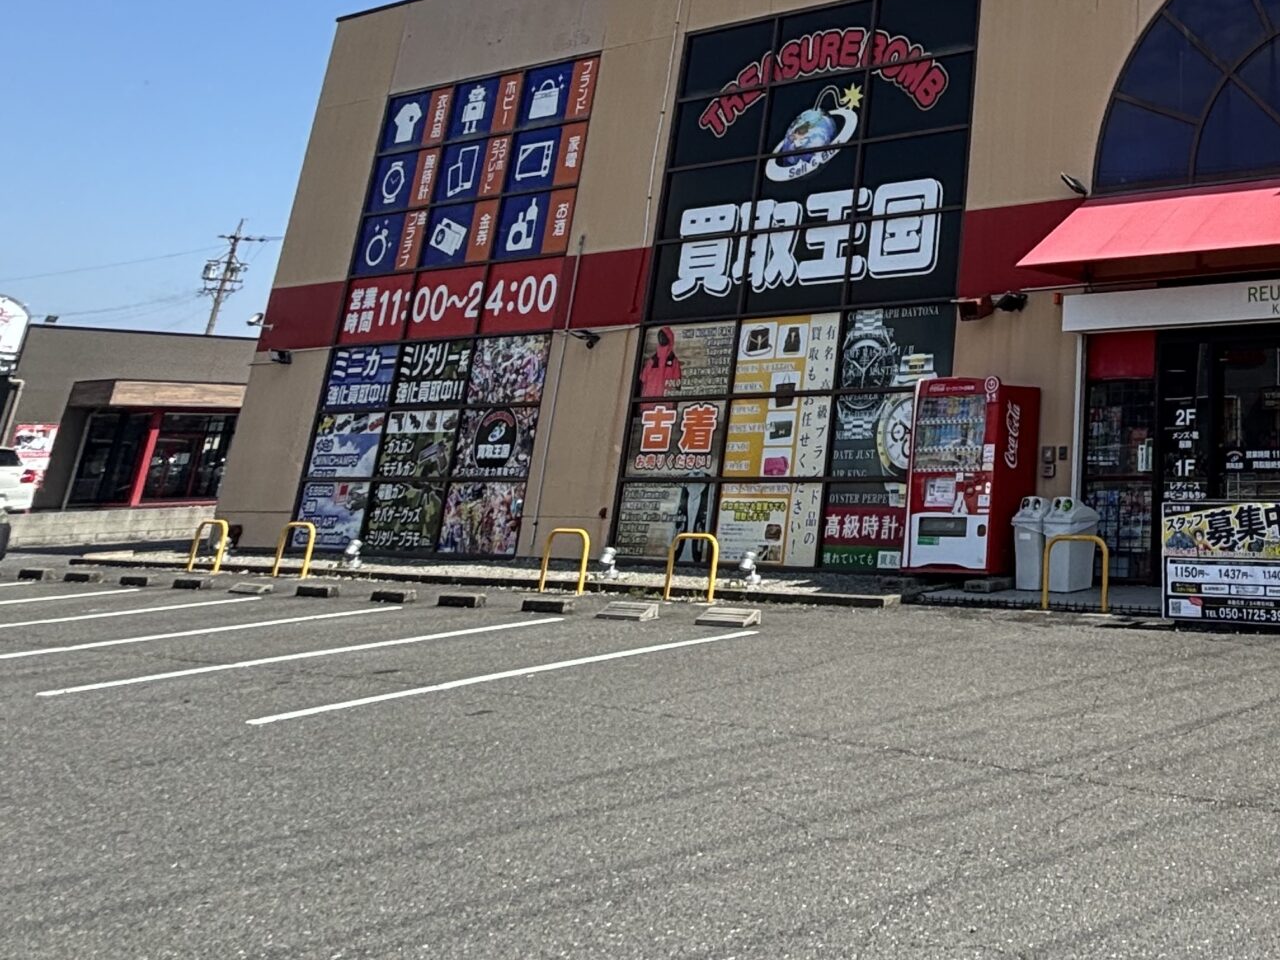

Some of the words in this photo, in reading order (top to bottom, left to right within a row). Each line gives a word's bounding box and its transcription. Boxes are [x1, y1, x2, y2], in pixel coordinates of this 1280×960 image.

[576, 60, 593, 115] ブランド
[700, 27, 867, 138] TREASURE
[862, 29, 949, 110] BOMB
[502, 80, 516, 125] ホビー
[788, 161, 807, 178] Sell
[552, 202, 569, 237] お酒
[671, 177, 944, 301] 買取王国
[350, 287, 379, 310] 営業
[343, 310, 374, 334] 時間
[902, 305, 940, 318] DAYTONA
[332, 347, 397, 378] ミニカー
[640, 403, 719, 454] 古着
[1175, 408, 1197, 426] 2F
[1003, 399, 1021, 470] Coca-Cola
[833, 449, 855, 460] DATE
[855, 449, 876, 460] JUST
[1175, 459, 1196, 477] 1F
[829, 493, 860, 504] OYSTER
[824, 513, 899, 540] 高級時計
[1166, 513, 1204, 532] スタッフ
[1205, 609, 1218, 618] TEL
